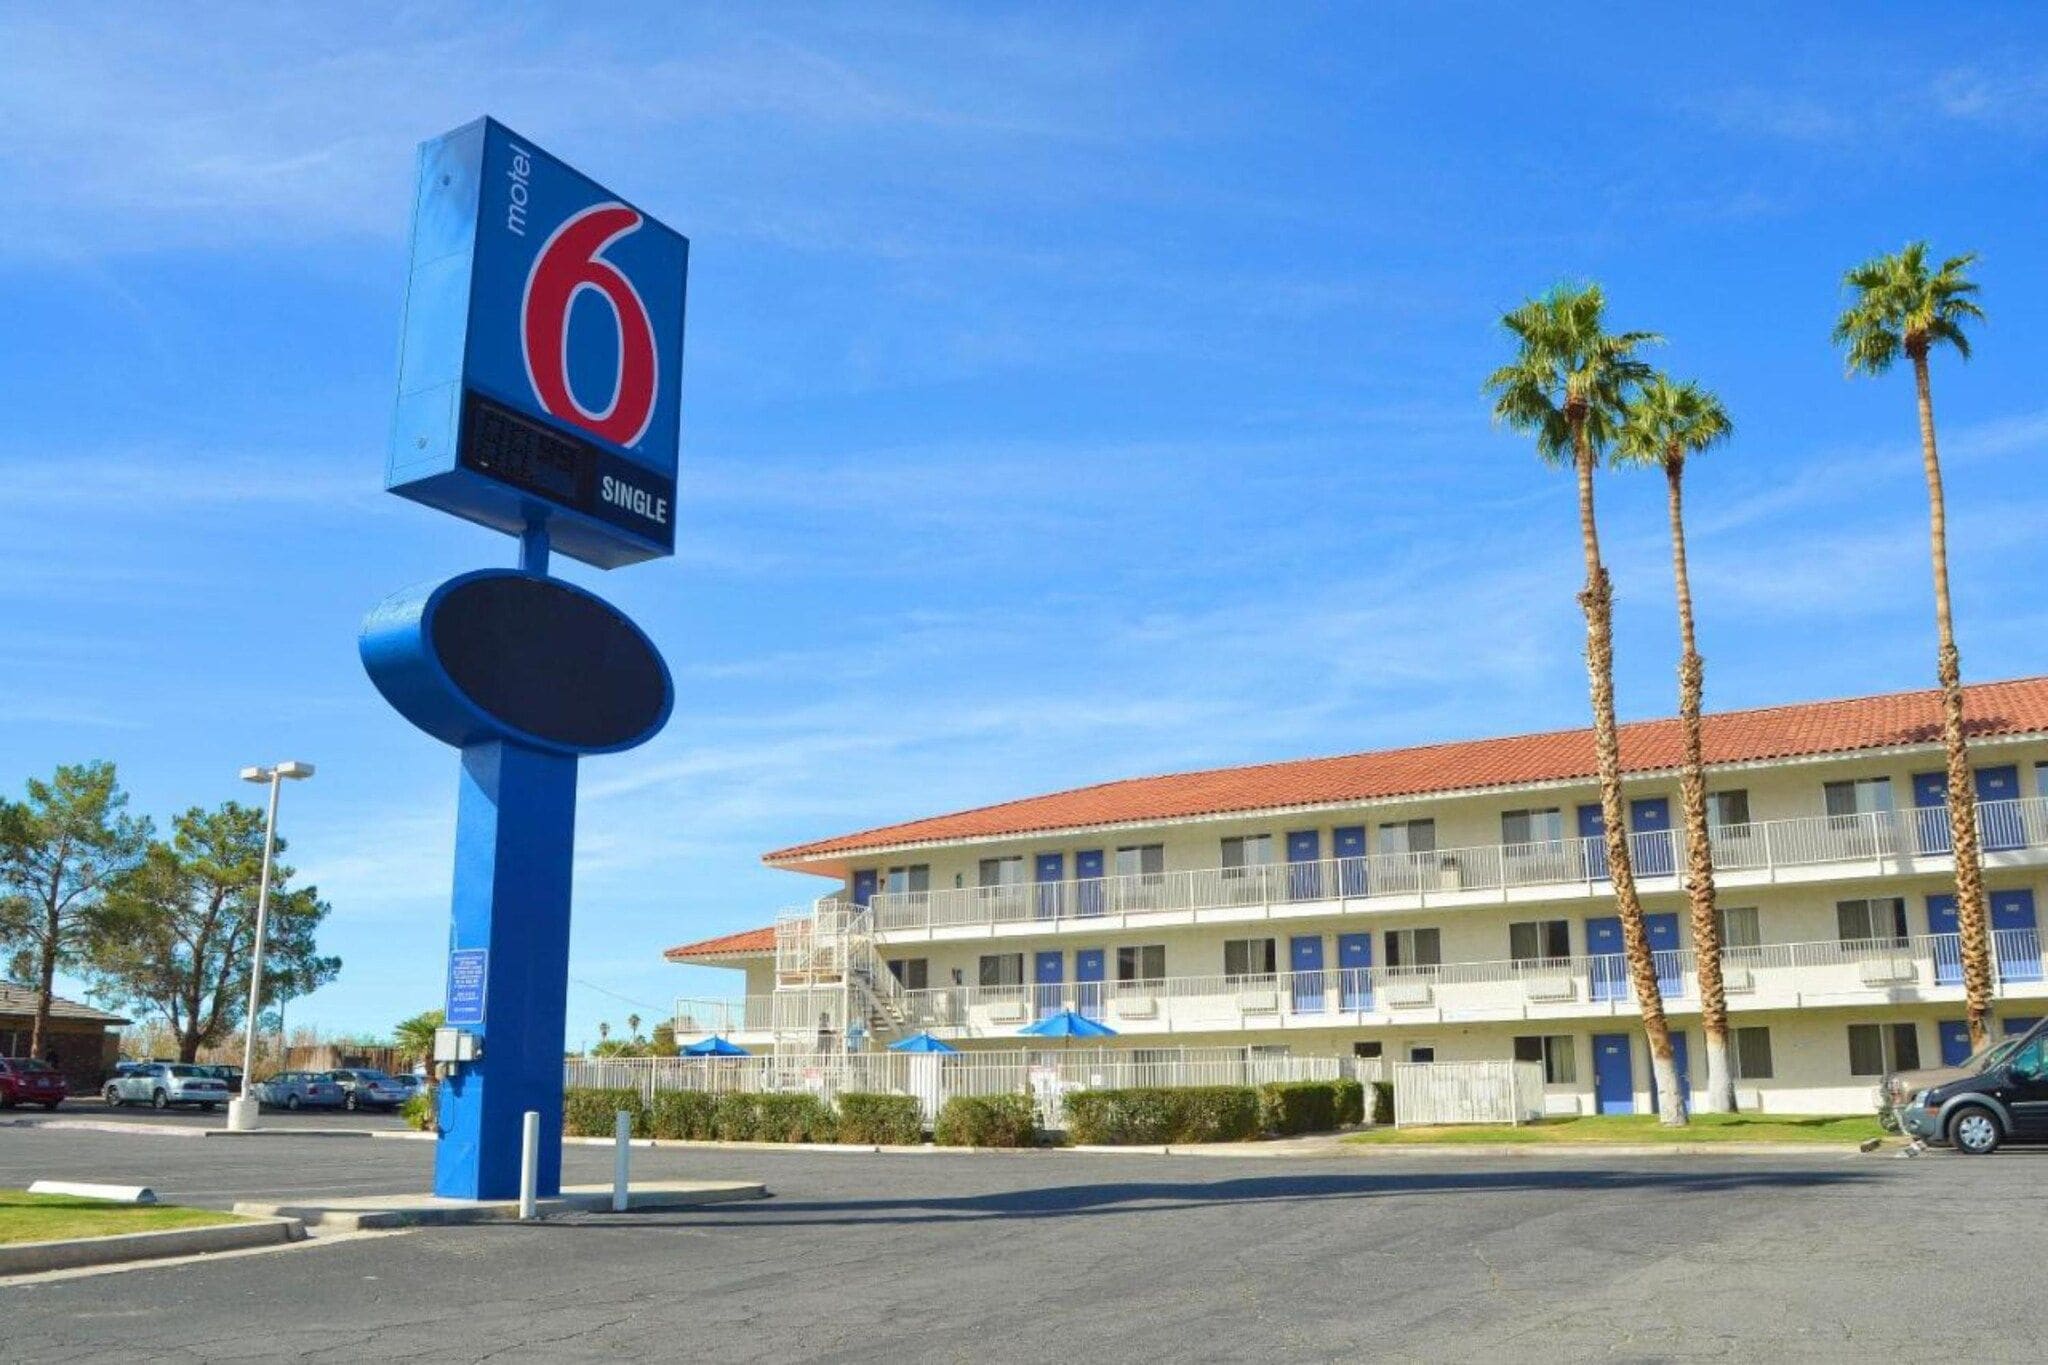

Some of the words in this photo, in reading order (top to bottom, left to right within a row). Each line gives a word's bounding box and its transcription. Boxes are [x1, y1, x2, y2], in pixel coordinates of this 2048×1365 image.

[506, 143, 531, 236] motel
[520, 201, 659, 449] 6
[601, 475, 667, 524] SINGLE
